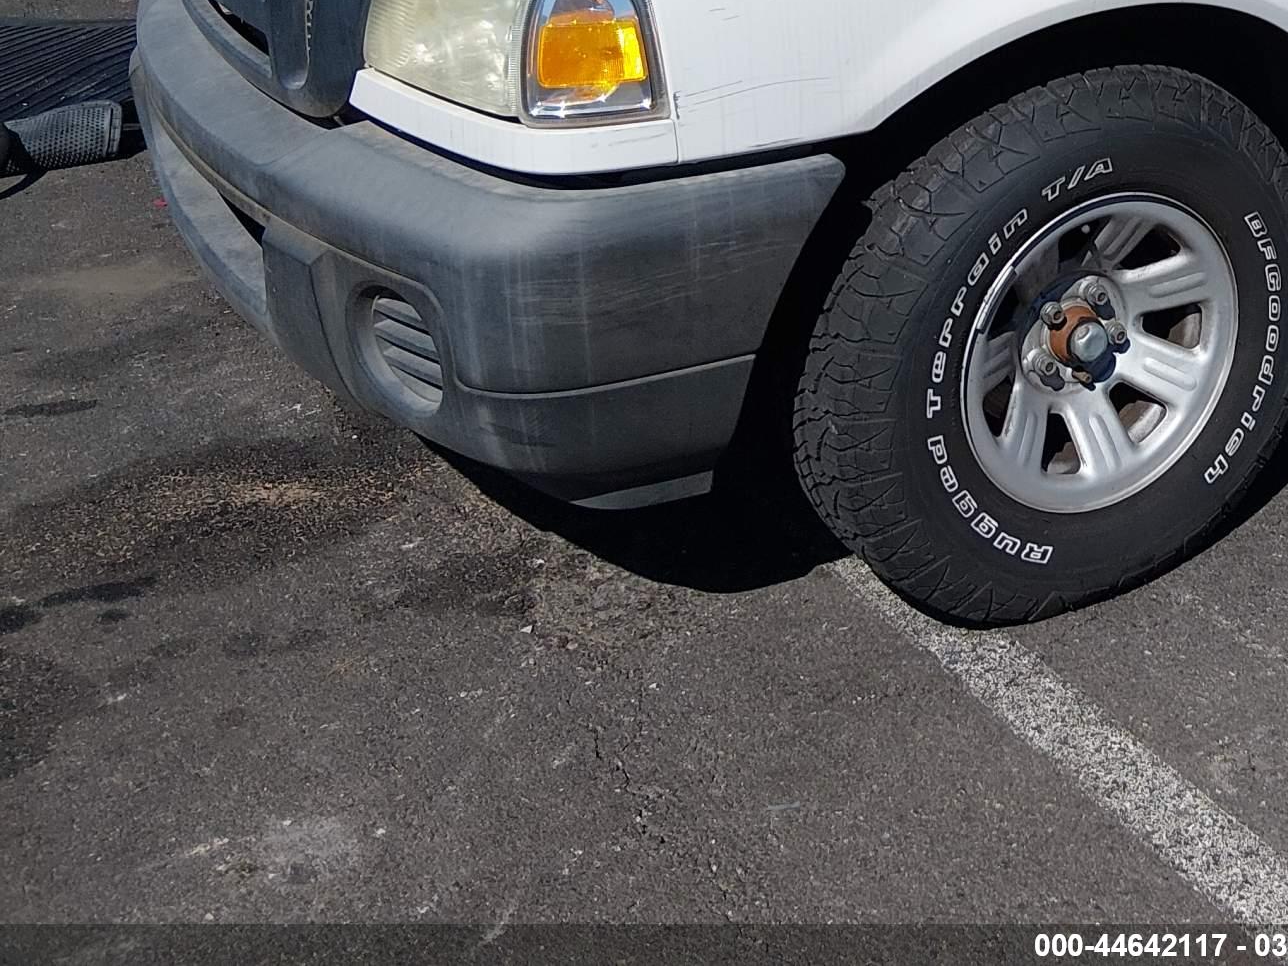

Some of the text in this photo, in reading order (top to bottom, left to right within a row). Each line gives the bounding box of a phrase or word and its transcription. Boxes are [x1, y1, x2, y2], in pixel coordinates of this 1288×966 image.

[926, 157, 1114, 564] Rugged Terrain T/A
[1203, 211, 1282, 484] BFGoodrich
